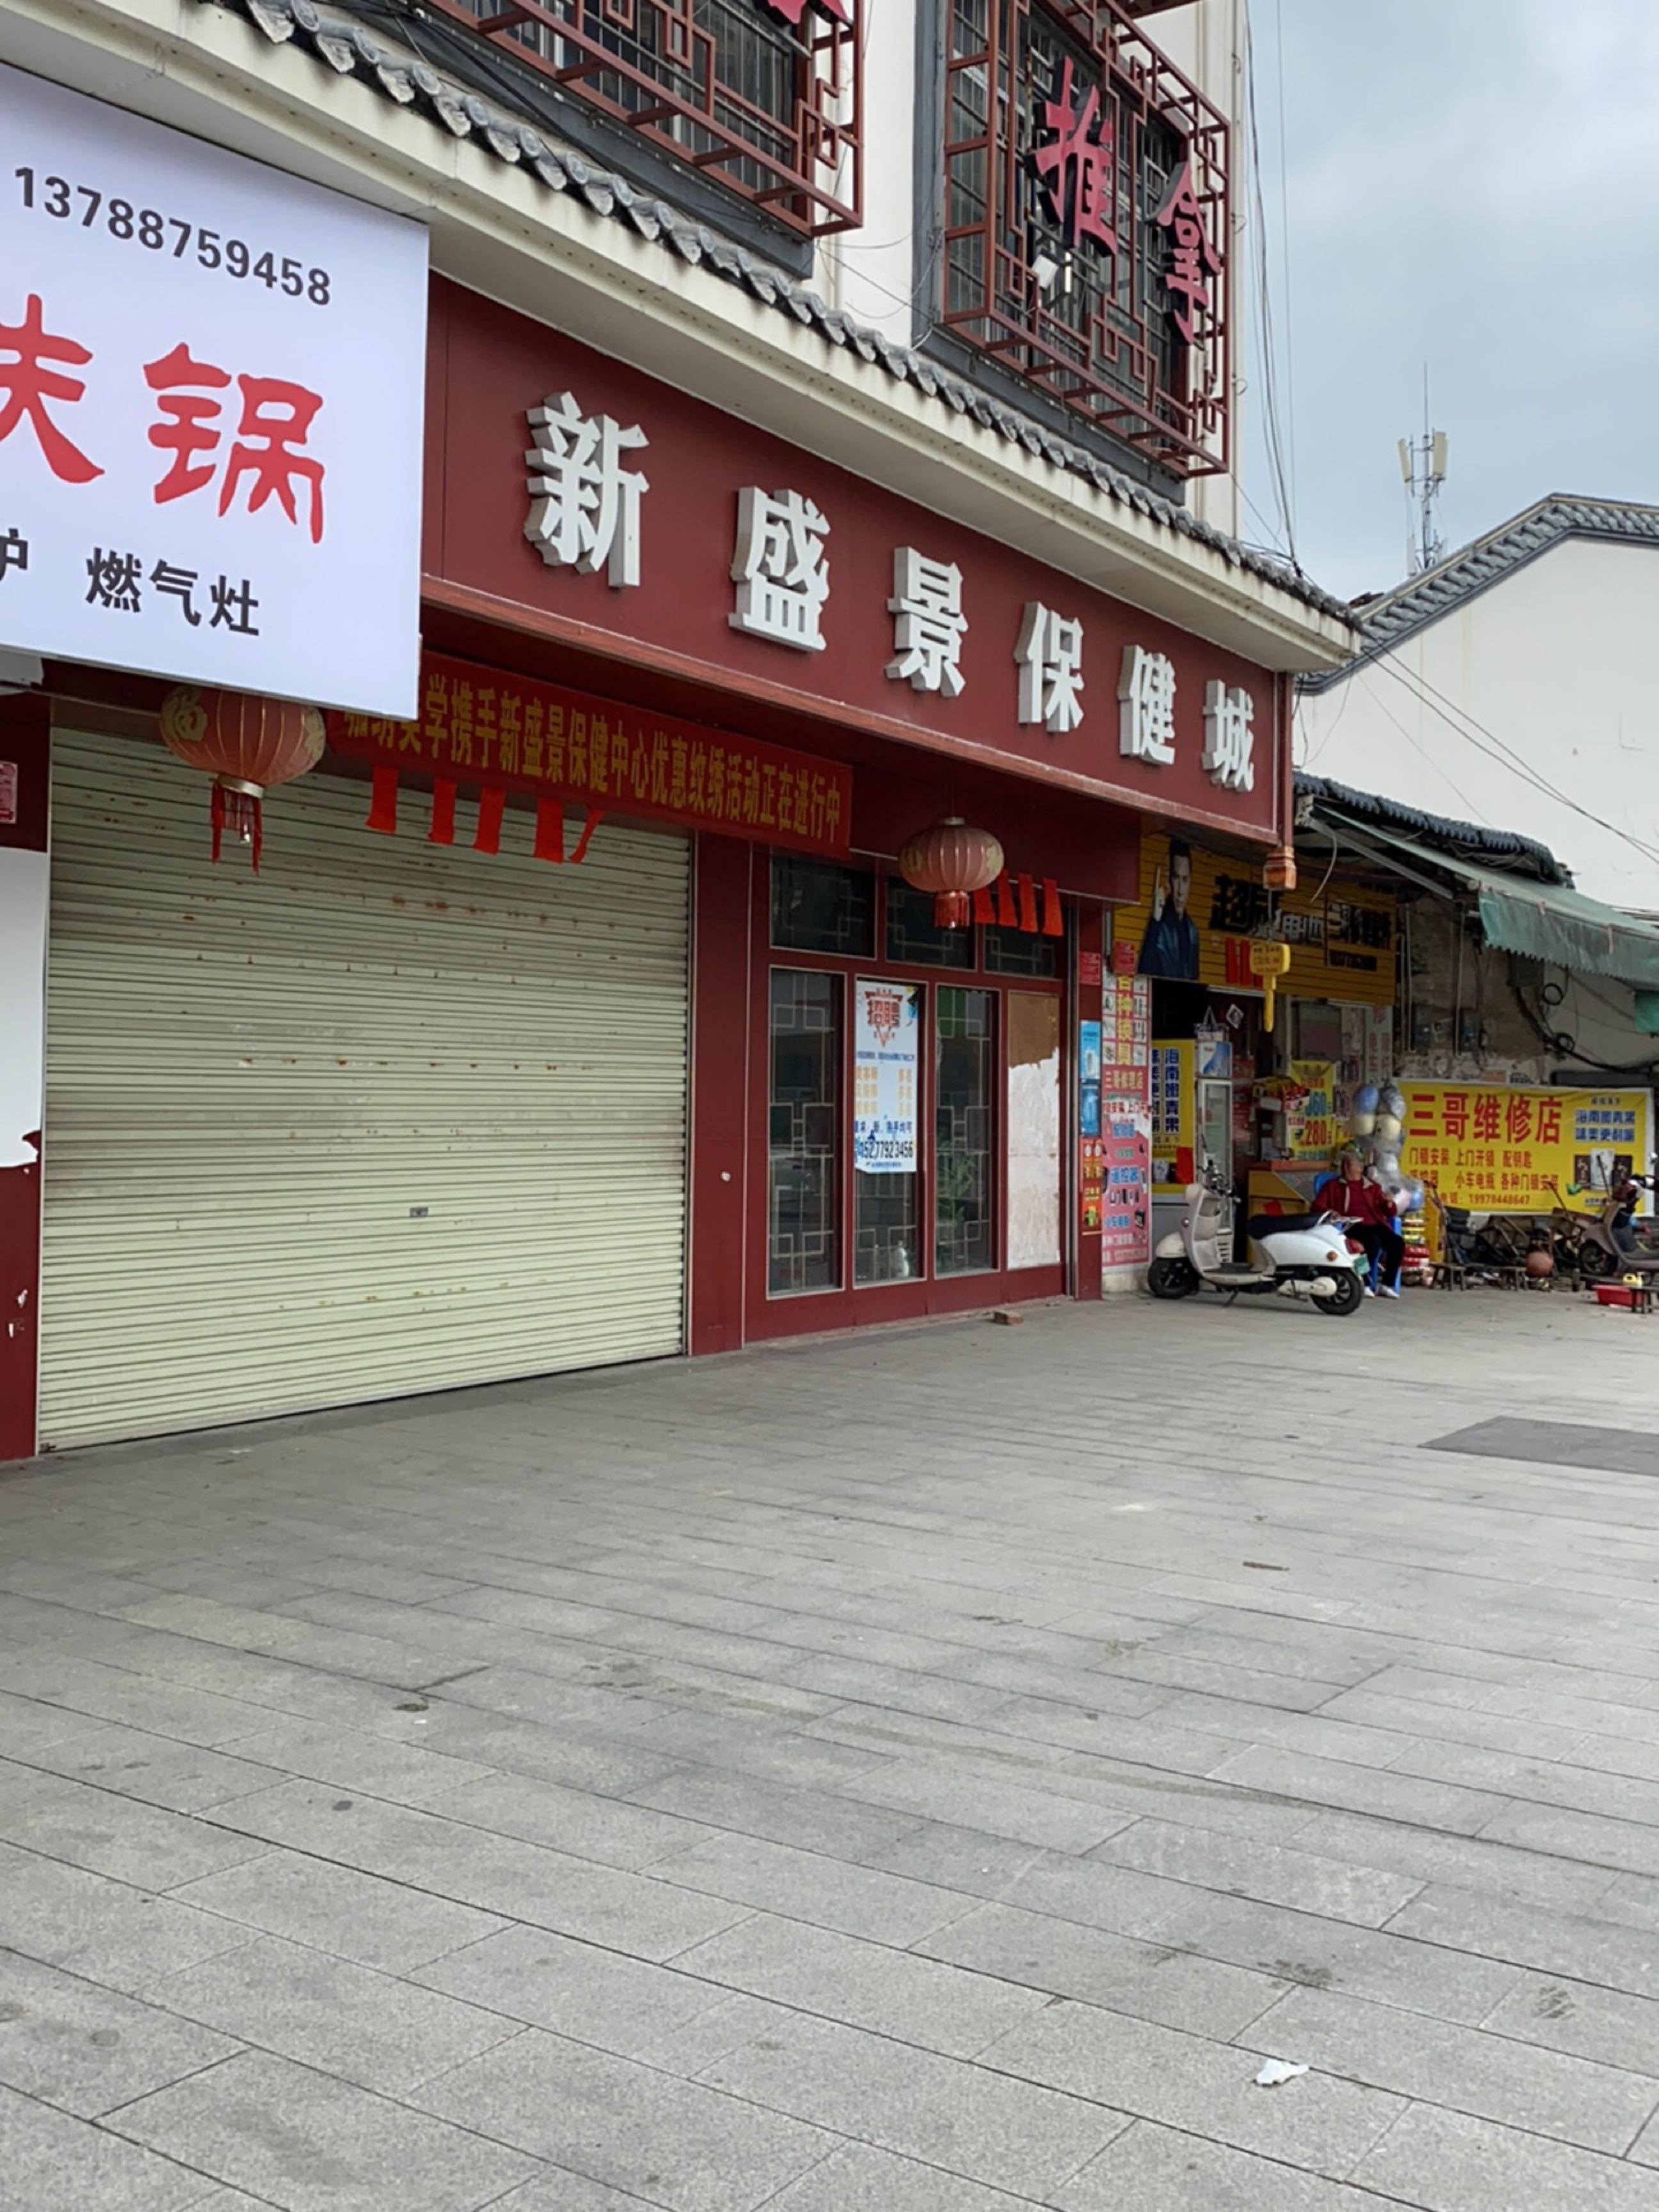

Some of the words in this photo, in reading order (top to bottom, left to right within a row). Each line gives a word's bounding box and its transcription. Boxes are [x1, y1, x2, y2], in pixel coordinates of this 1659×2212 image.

[15, 166, 332, 305] 13788759458
[86, 546, 260, 637] 燃气灶
[524, 390, 1254, 792] 新盛景保健城
[1409, 1093, 1562, 1144] 三哥维修店
[1455, 1149, 1495, 1167] 上门开锁
